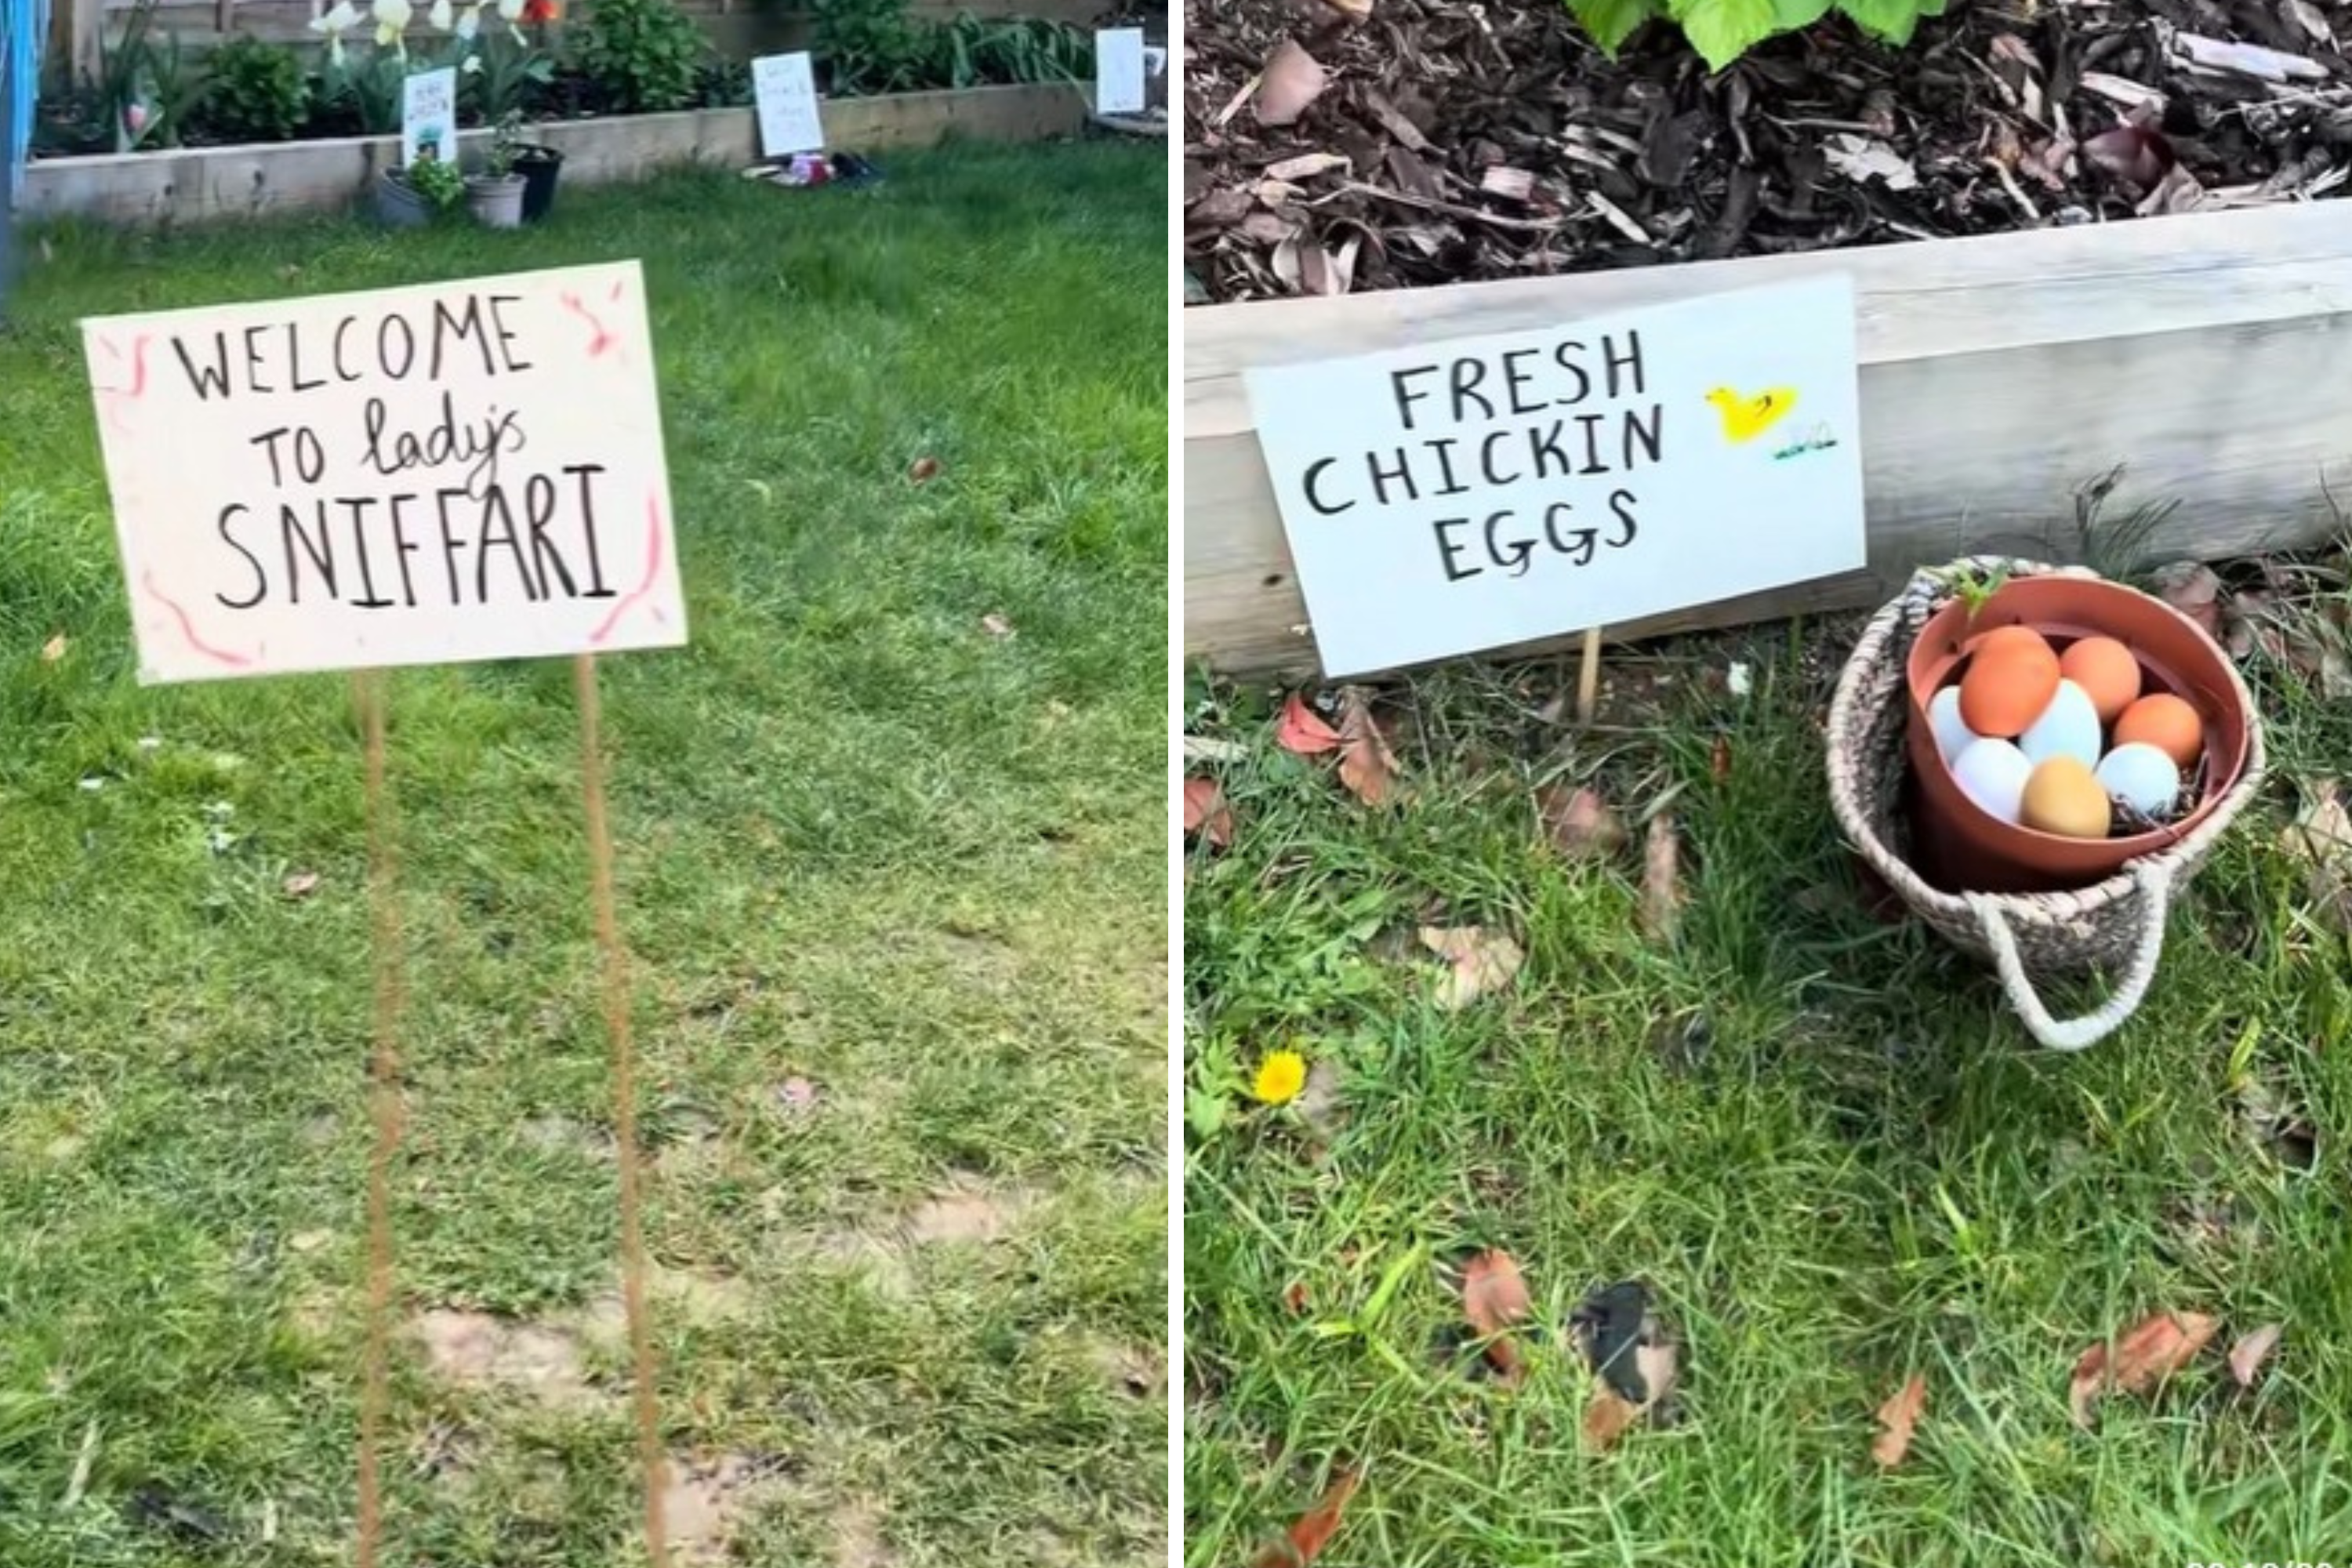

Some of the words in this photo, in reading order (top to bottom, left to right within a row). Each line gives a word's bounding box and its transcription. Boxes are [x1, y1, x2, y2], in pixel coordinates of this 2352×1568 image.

[171, 294, 534, 401] WELCOME
[1391, 329, 1646, 430] FRESH
[250, 426, 325, 487] TO
[1301, 402, 1664, 516] CHICKIN
[215, 464, 618, 610] SNIFFARI
[1432, 488, 1639, 583] EGGS
